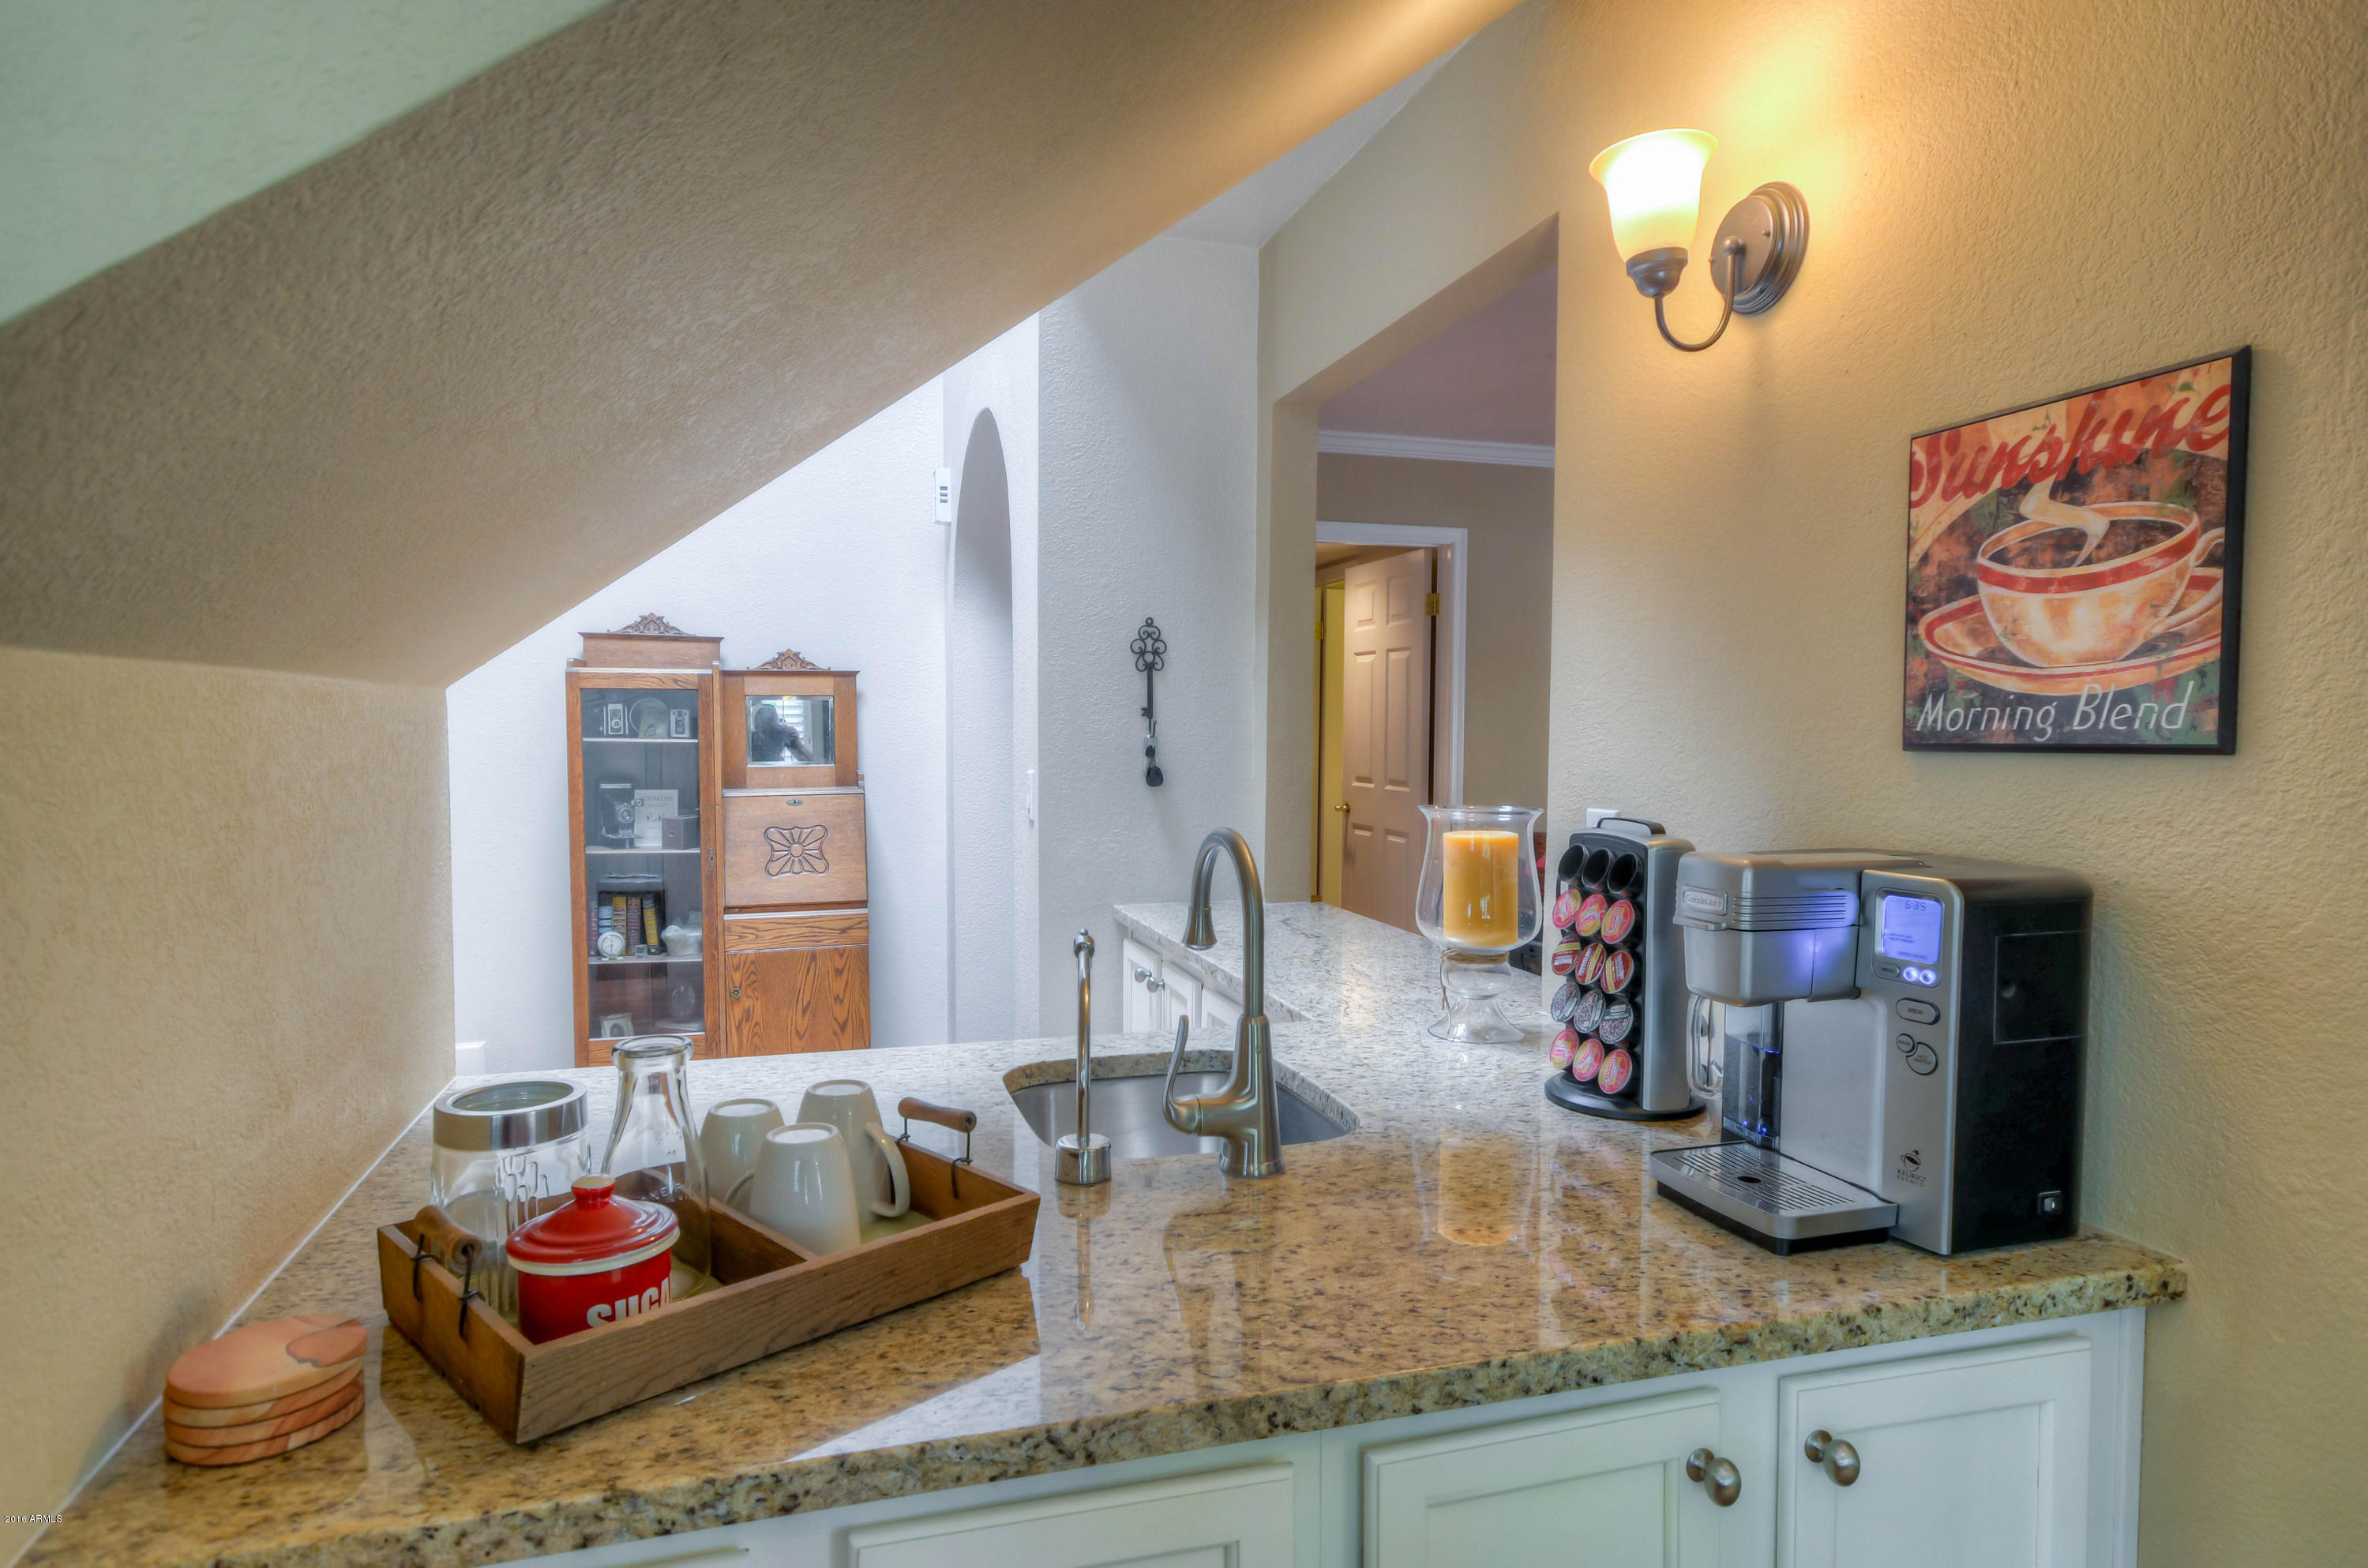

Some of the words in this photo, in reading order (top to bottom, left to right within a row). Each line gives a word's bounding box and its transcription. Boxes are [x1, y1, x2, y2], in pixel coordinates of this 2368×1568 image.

[1910, 379, 2231, 509] Sunshine
[1915, 693, 2057, 742] Morning
[2073, 681, 2195, 731] Blend
